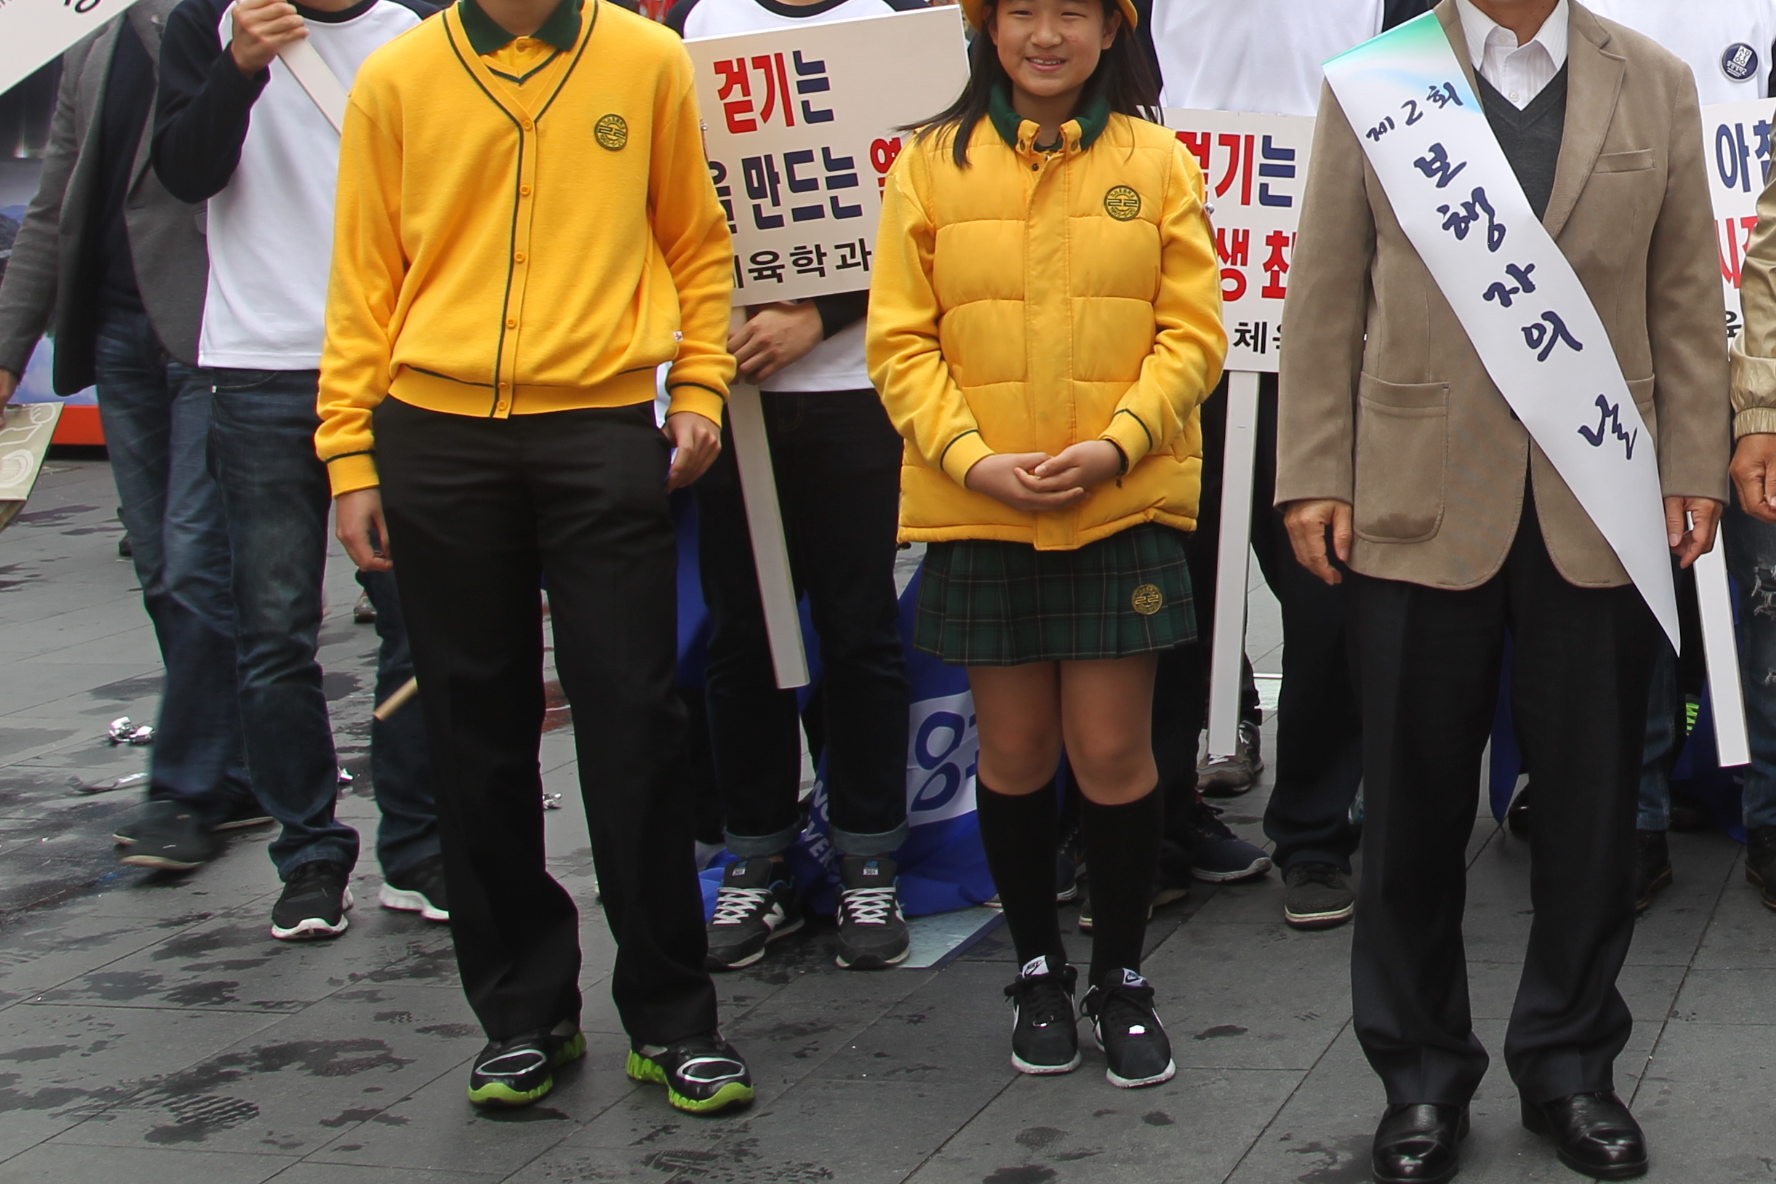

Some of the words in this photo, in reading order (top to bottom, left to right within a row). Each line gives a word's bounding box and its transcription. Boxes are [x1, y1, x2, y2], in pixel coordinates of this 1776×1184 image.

[713, 50, 835, 134] 걷기는
[741, 146, 864, 231] 만드는
[1576, 392, 1640, 462] 날
